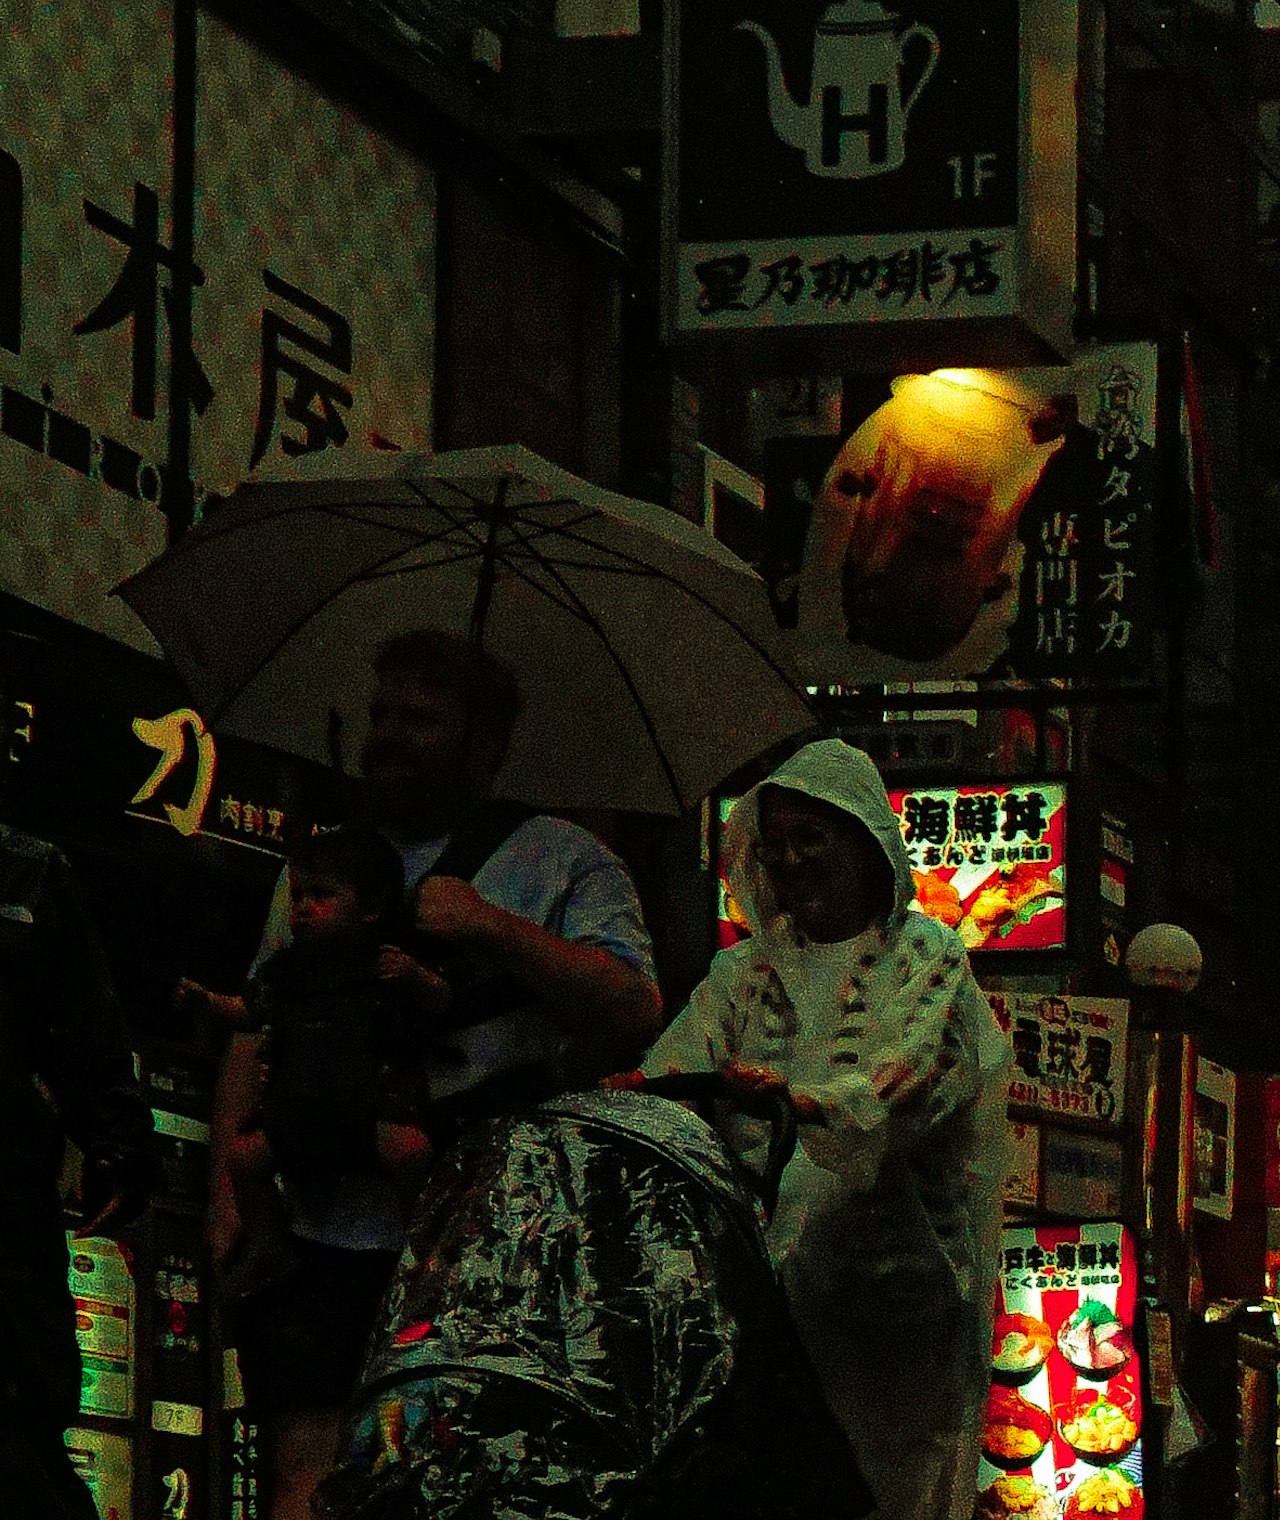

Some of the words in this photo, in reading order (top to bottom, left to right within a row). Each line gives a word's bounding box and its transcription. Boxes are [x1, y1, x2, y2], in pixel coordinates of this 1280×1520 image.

[945, 152, 998, 202] 1F
[0, 148, 353, 472] 木屋
[693, 241, 1001, 316] 星乃珈琲店
[905, 792, 1047, 844] 海鮮丼
